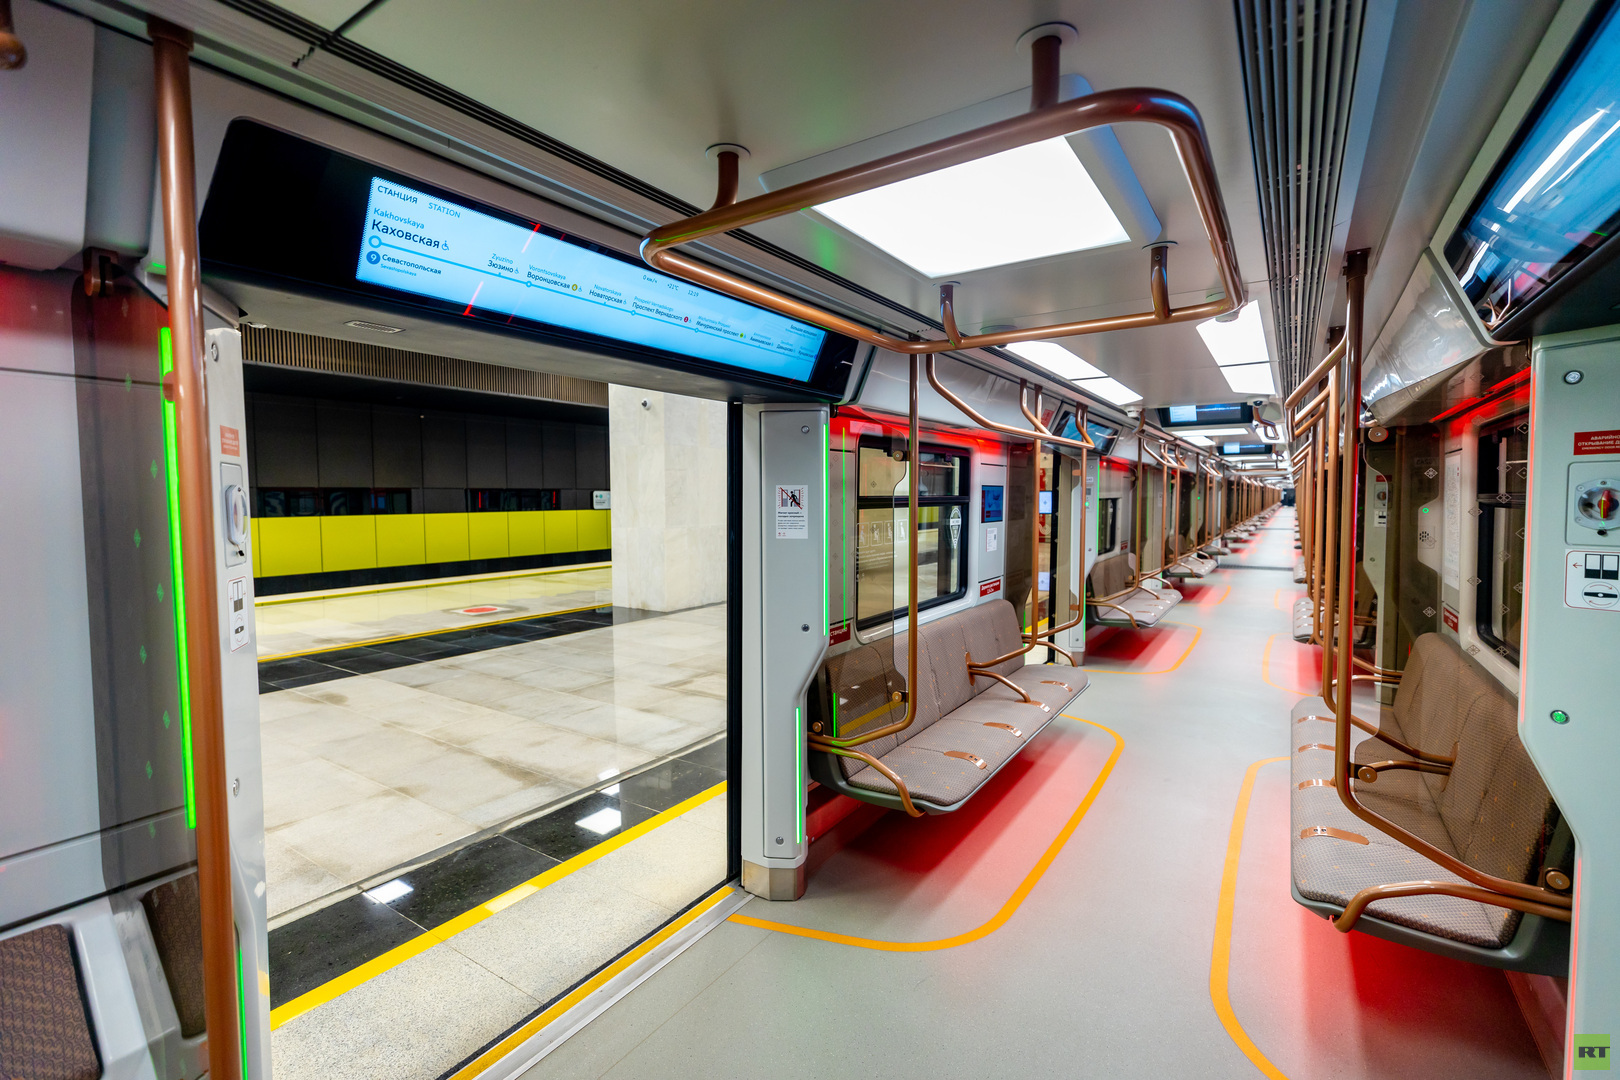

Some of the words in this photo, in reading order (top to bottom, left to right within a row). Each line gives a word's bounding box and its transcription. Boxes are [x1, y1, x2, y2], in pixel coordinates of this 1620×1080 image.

[377, 185, 418, 204] СТАНЦИЯ
[373, 207, 425, 230] Kakhovskaya
[428, 202, 461, 218] STATION
[371, 219, 440, 249] Каховская
[381, 253, 442, 275] Севастопольская
[487, 259, 514, 273] Зюзино
[491, 253, 514, 265] Zyuzino
[526, 271, 571, 289] Воронцовская
[528, 264, 566, 280] Vorontsovskaya
[589, 289, 623, 304] Новаторская
